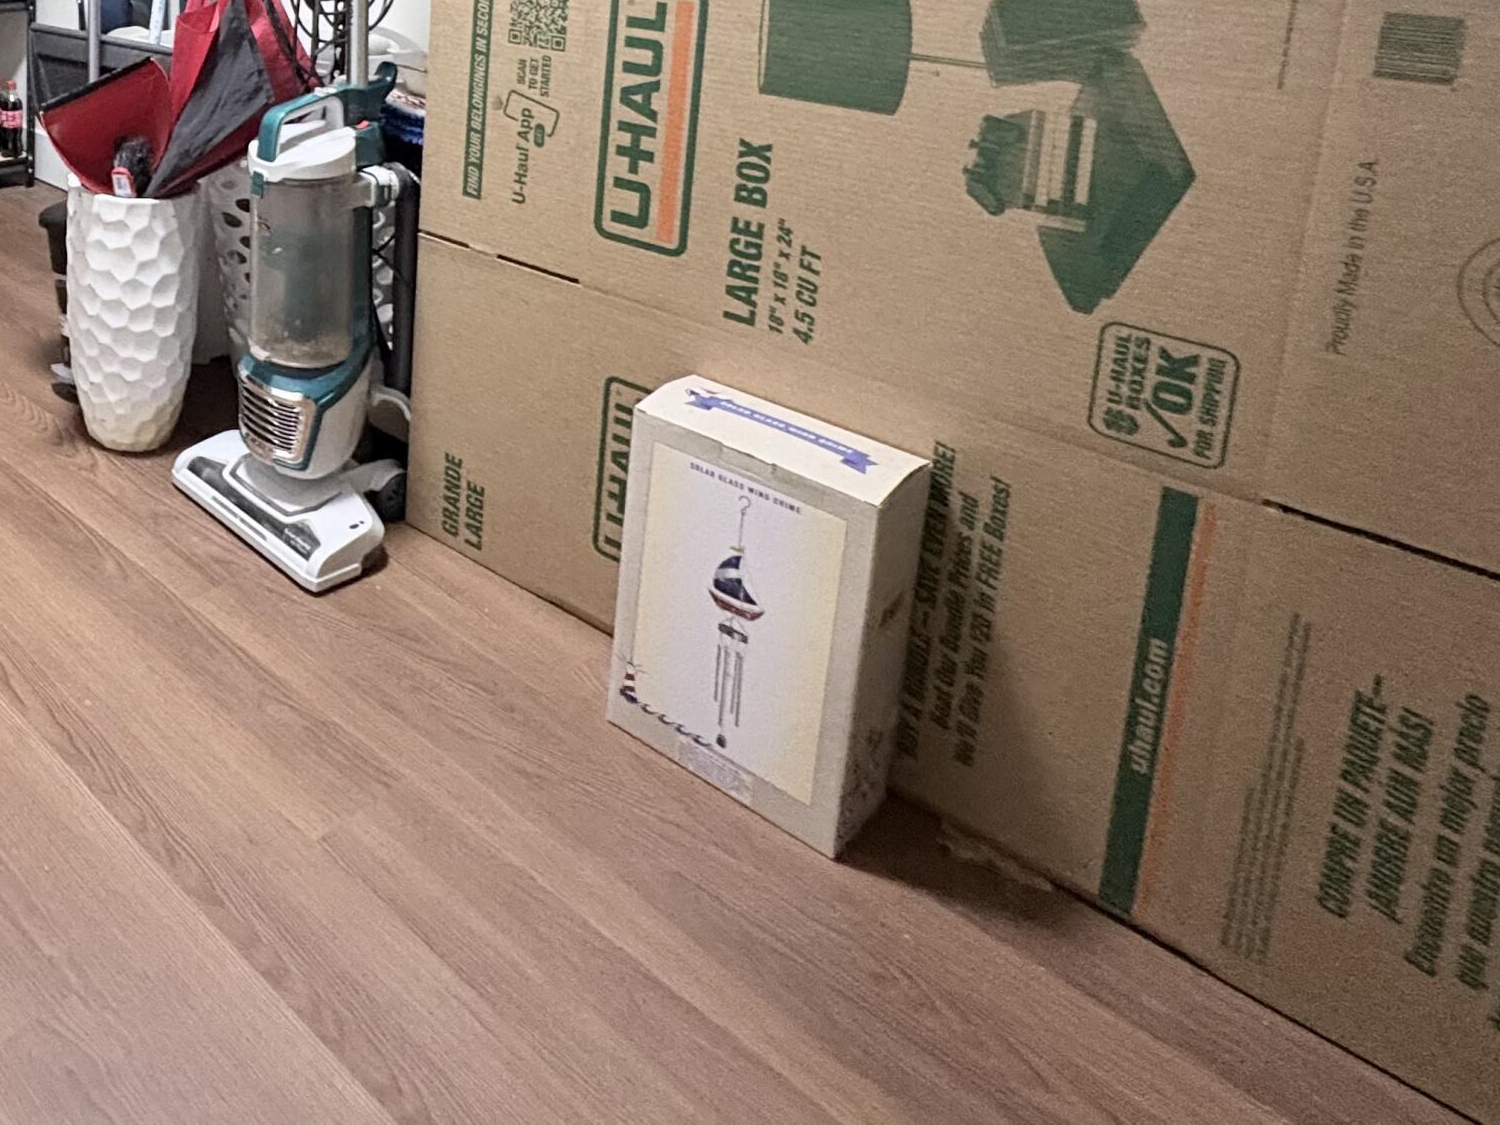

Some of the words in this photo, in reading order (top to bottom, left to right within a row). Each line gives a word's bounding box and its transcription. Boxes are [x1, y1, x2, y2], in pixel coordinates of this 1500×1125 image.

[477, 38, 487, 54] IN
[471, 54, 488, 133] BELONGINGS
[517, 59, 527, 85] SCAN
[528, 75, 538, 90] TO
[540, 55, 552, 97] STARTED
[518, 107, 535, 143] App
[610, 1, 668, 230] U-HAUL
[469, 131, 483, 166] YOUR
[466, 165, 480, 196] FIND
[733, 137, 774, 209] BOX
[723, 216, 765, 328] LARGE
[799, 245, 823, 276] FT
[794, 275, 820, 309] CU
[792, 305, 817, 345] 4.5
[1324, 297, 1356, 355] Proudly
[1150, 346, 1202, 415] OK
[442, 451, 463, 536] GRANDE
[464, 480, 486, 550] LARGE
[975, 541, 1003, 590] FREE
[1127, 636, 1168, 775] uhaul.com
